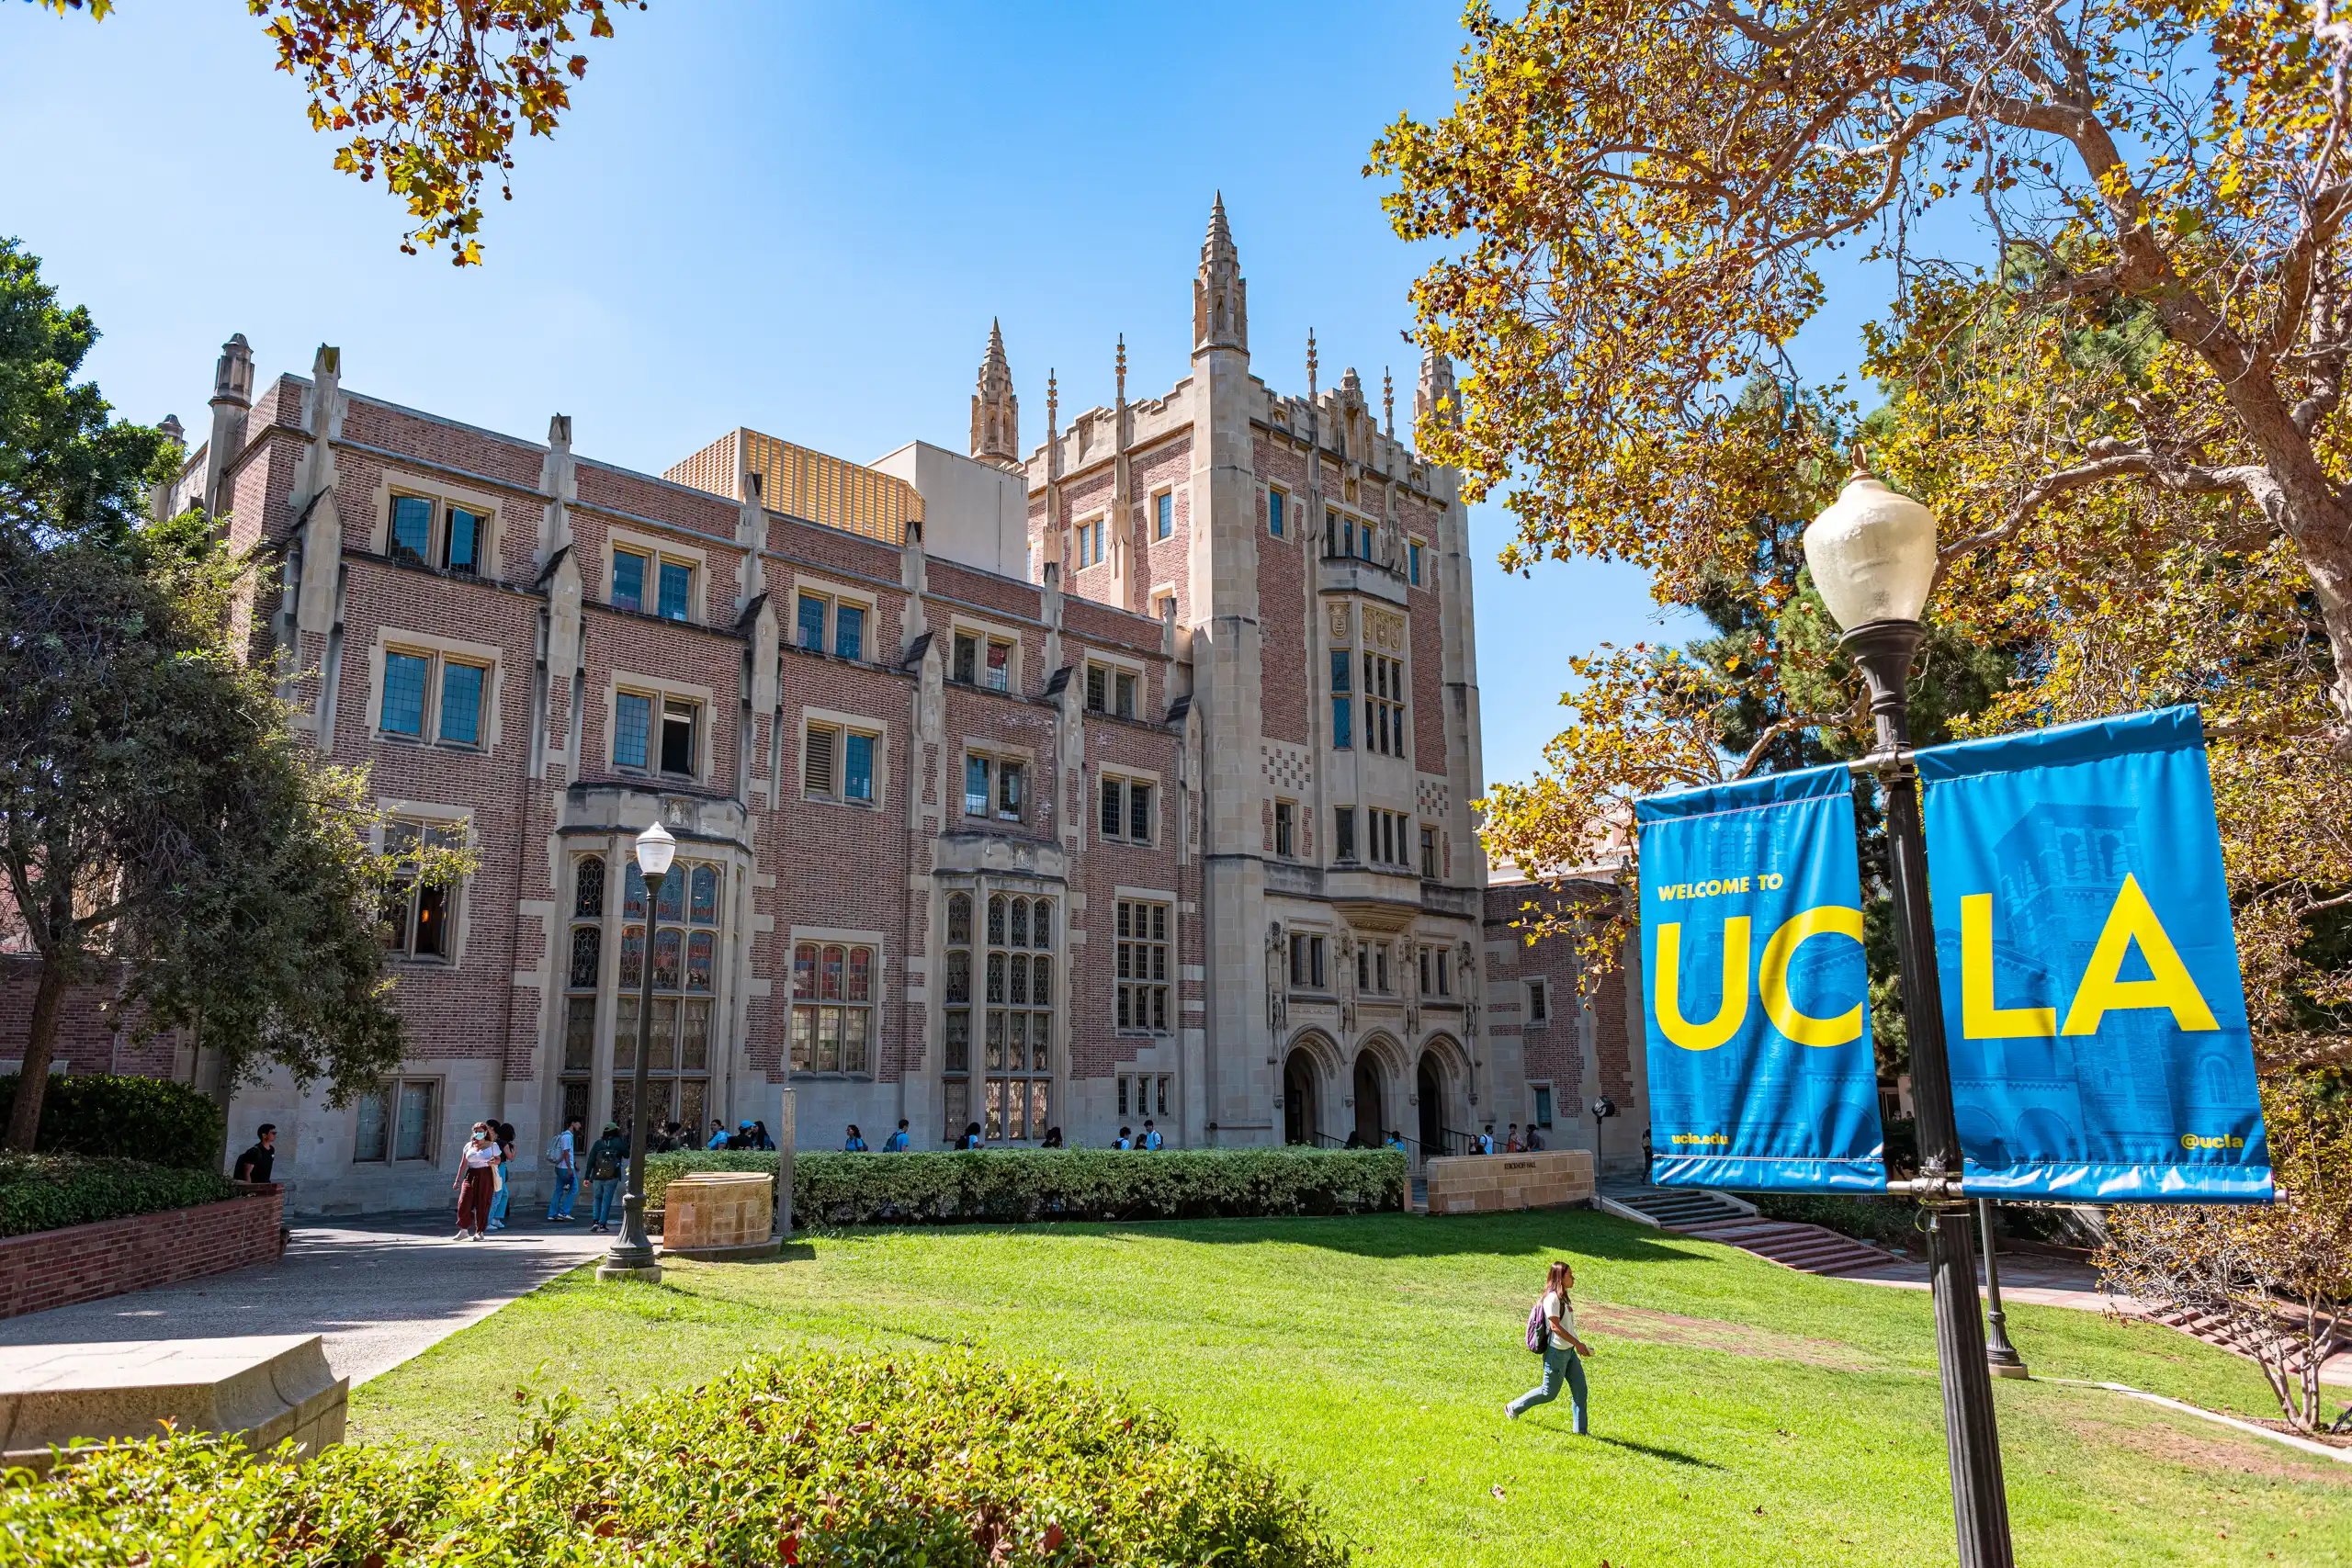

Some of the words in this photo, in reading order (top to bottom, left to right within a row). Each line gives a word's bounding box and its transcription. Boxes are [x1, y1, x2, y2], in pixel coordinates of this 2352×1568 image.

[1657, 876, 1750, 901] WELCOME
[1758, 873, 1783, 890] TO
[1655, 906, 1865, 1051] UC
[1962, 874, 2222, 1040] LA
[1671, 1132, 1729, 1145] ucla.edu
[2180, 1134, 2245, 1150] @ucla
